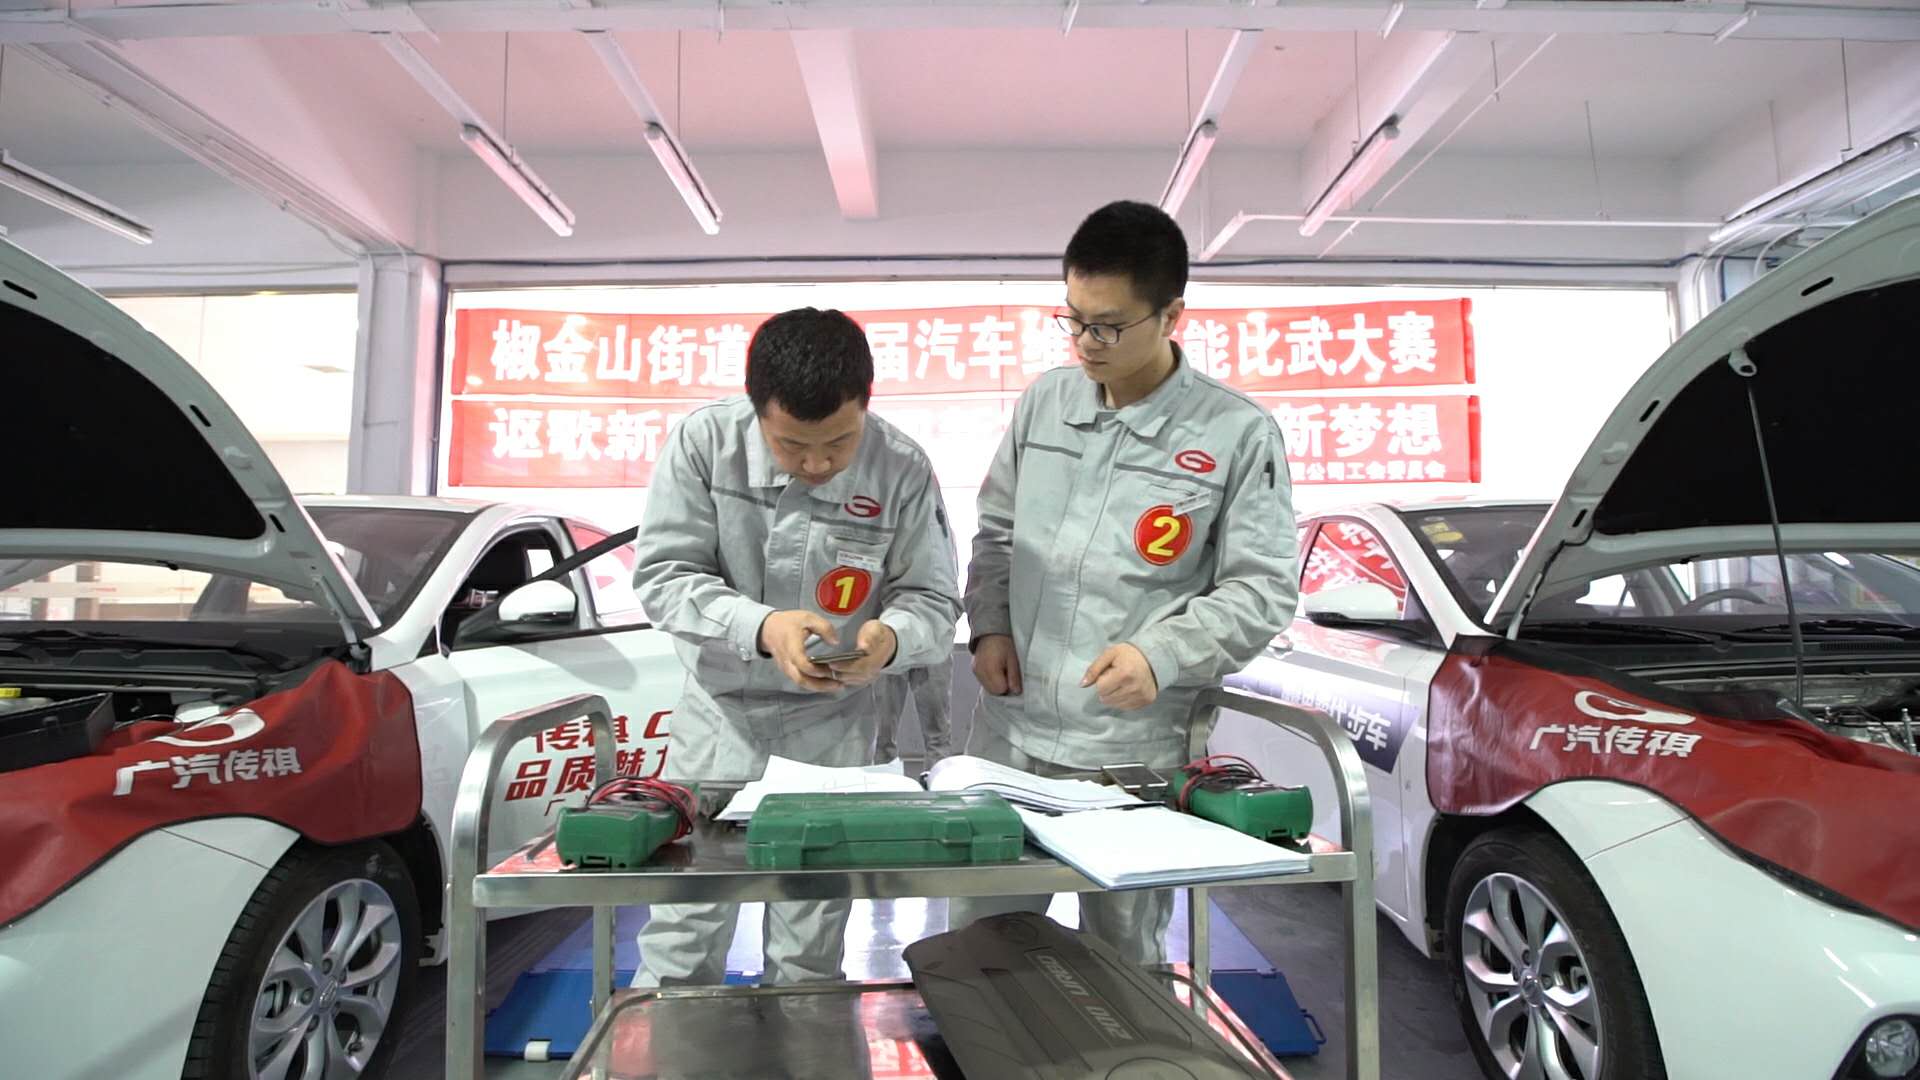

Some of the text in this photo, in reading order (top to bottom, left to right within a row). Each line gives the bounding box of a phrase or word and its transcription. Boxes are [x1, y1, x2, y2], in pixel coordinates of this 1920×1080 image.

[490, 310, 1439, 387] 椒金山街道届汽车维能比武大赛
[1147, 516, 1181, 557] 2
[834, 576, 855, 609] 1
[1529, 723, 1703, 758] 广汽传祺
[112, 746, 303, 797] 广汽传祺
